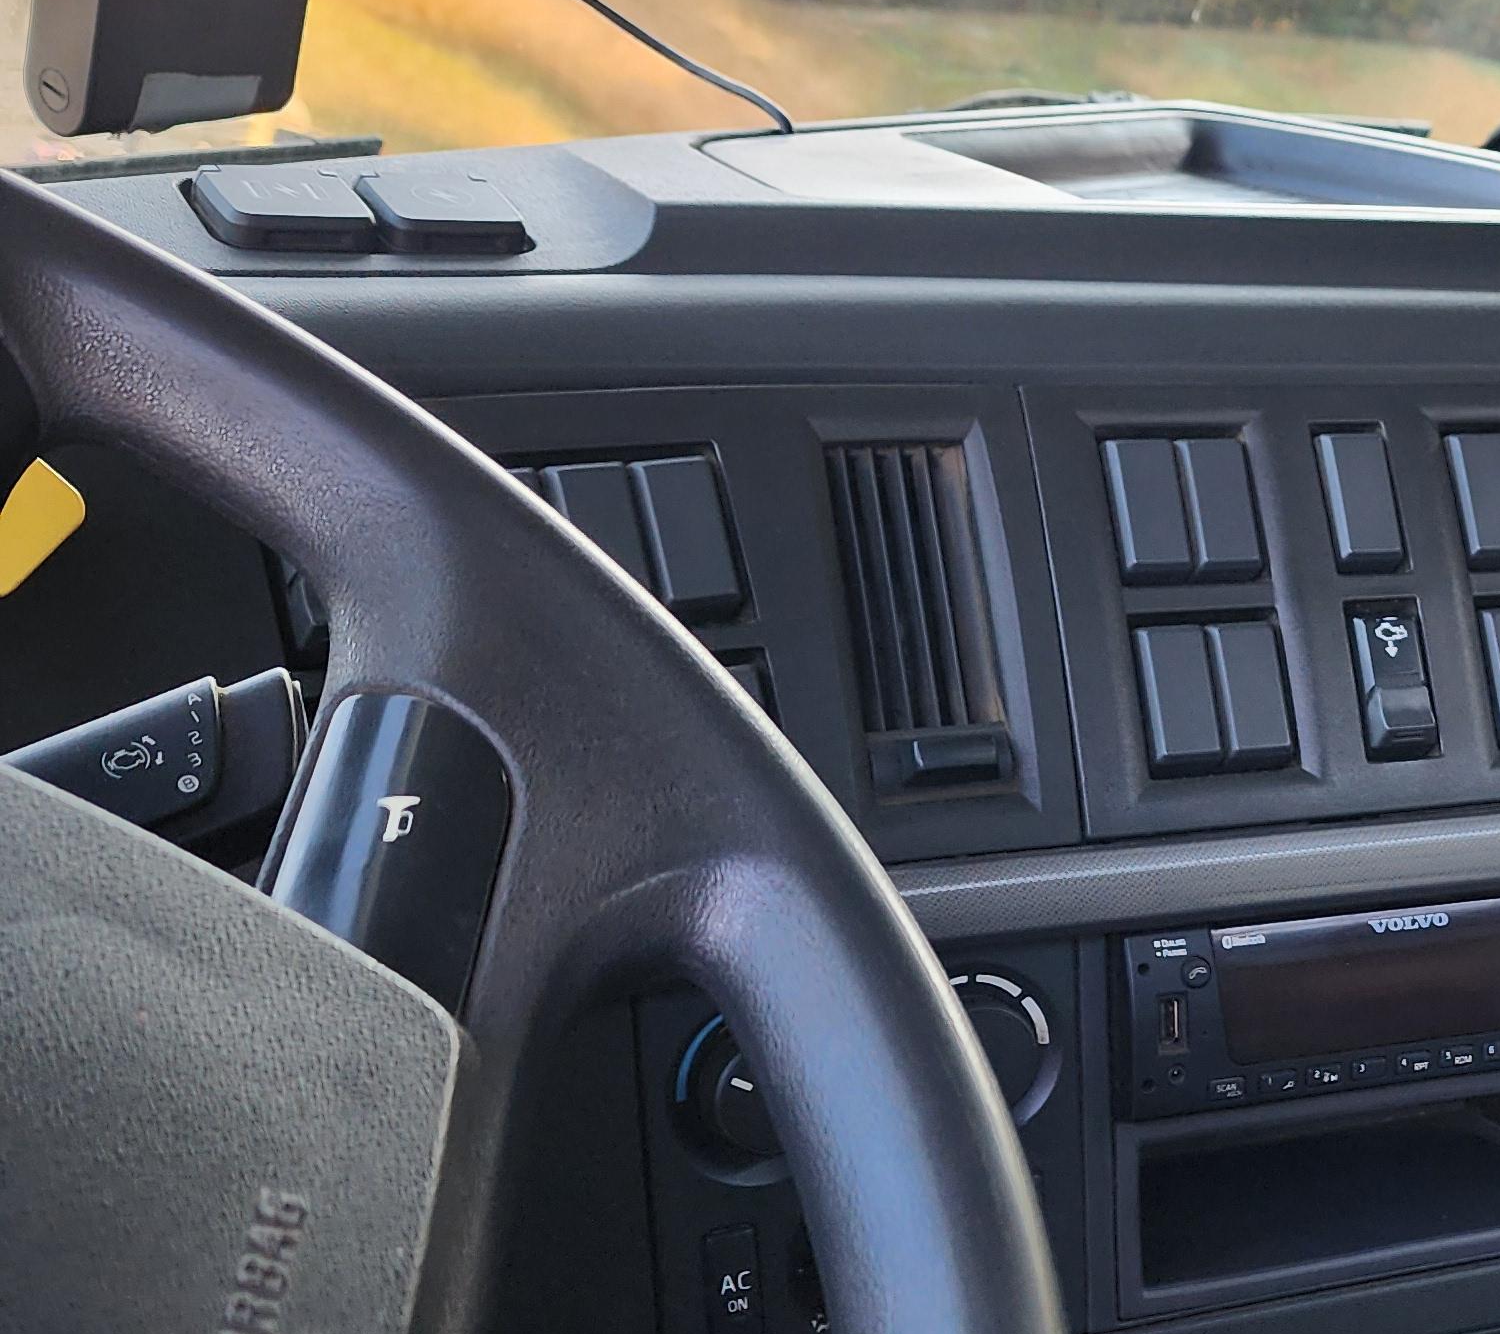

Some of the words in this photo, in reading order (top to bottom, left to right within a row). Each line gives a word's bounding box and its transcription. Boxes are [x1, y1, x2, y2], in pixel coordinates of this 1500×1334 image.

[187, 692, 202, 706] A
[187, 730, 203, 745] 2
[187, 752, 202, 768] 3
[1367, 912, 1449, 934] VOLVO
[720, 1270, 752, 1295] AC
[727, 1296, 749, 1313] ON
